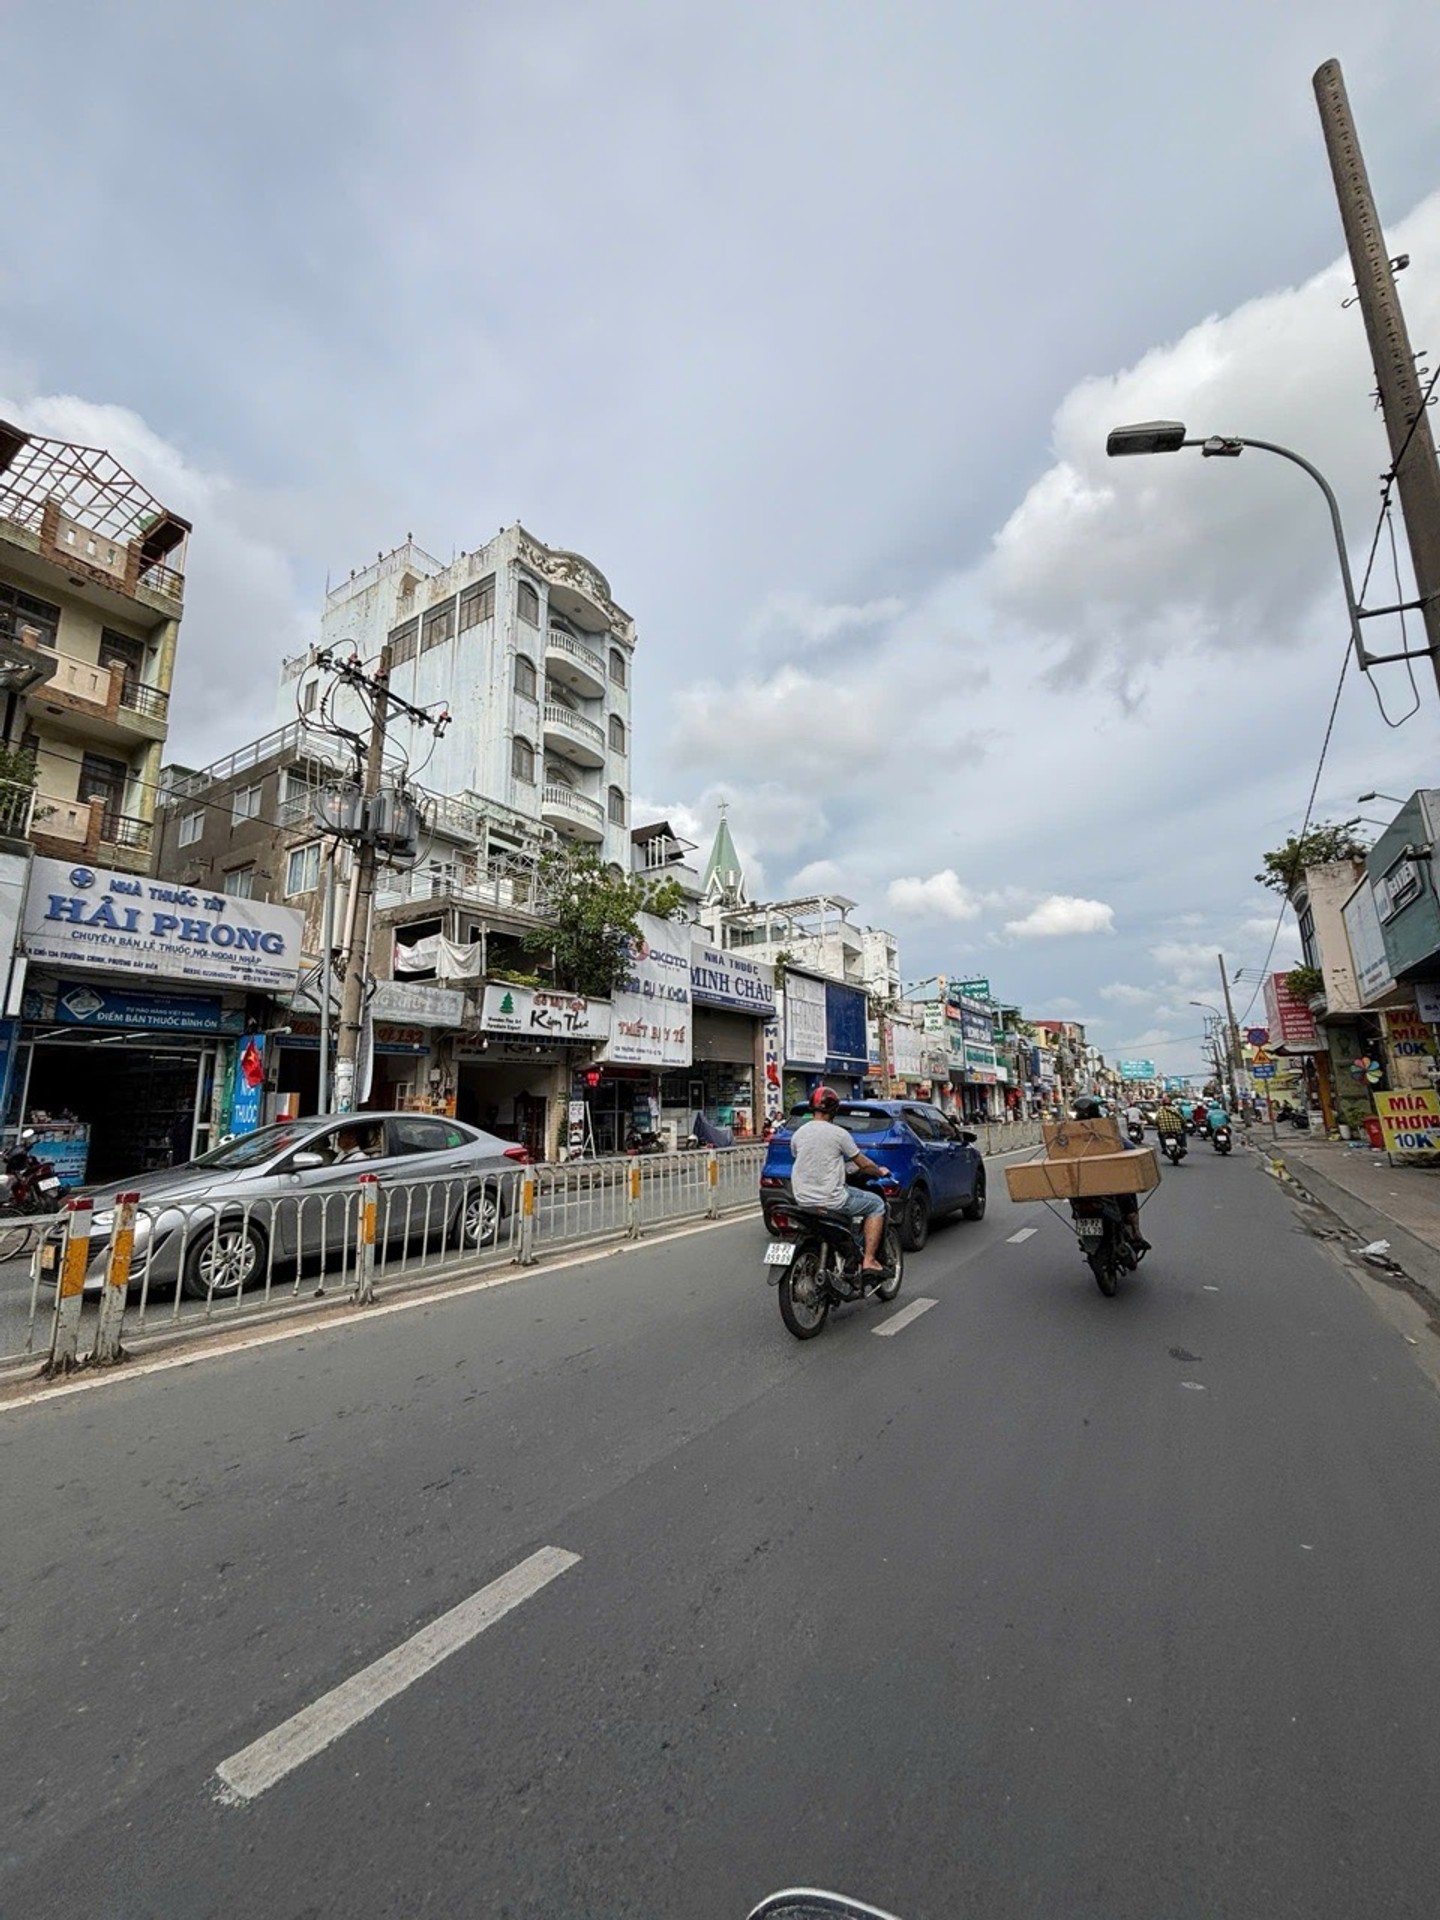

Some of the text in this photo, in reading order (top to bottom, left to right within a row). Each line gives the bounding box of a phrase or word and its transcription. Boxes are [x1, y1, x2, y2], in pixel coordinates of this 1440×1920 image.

[110, 879, 142, 897] NHÀ
[149, 886, 198, 908] THUỐC
[44, 894, 286, 955] HẢI PHONG
[71, 930, 117, 946] CHUYÊN
[118, 936, 144, 950] BÁN
[160, 943, 191, 956] THUỐC
[735, 977, 773, 1003] CHÂU
[97, 1011, 124, 1022] ĐIỂM
[124, 1014, 145, 1023] BÁN
[147, 1014, 181, 1026] THUỐC
[181, 1017, 204, 1027] BÌNH
[529, 1009, 563, 1032] Kim
[1394, 1042, 1428, 1056] 10K
[1388, 1093, 1429, 1110] MÍA
[1394, 1132, 1437, 1149] 10K
